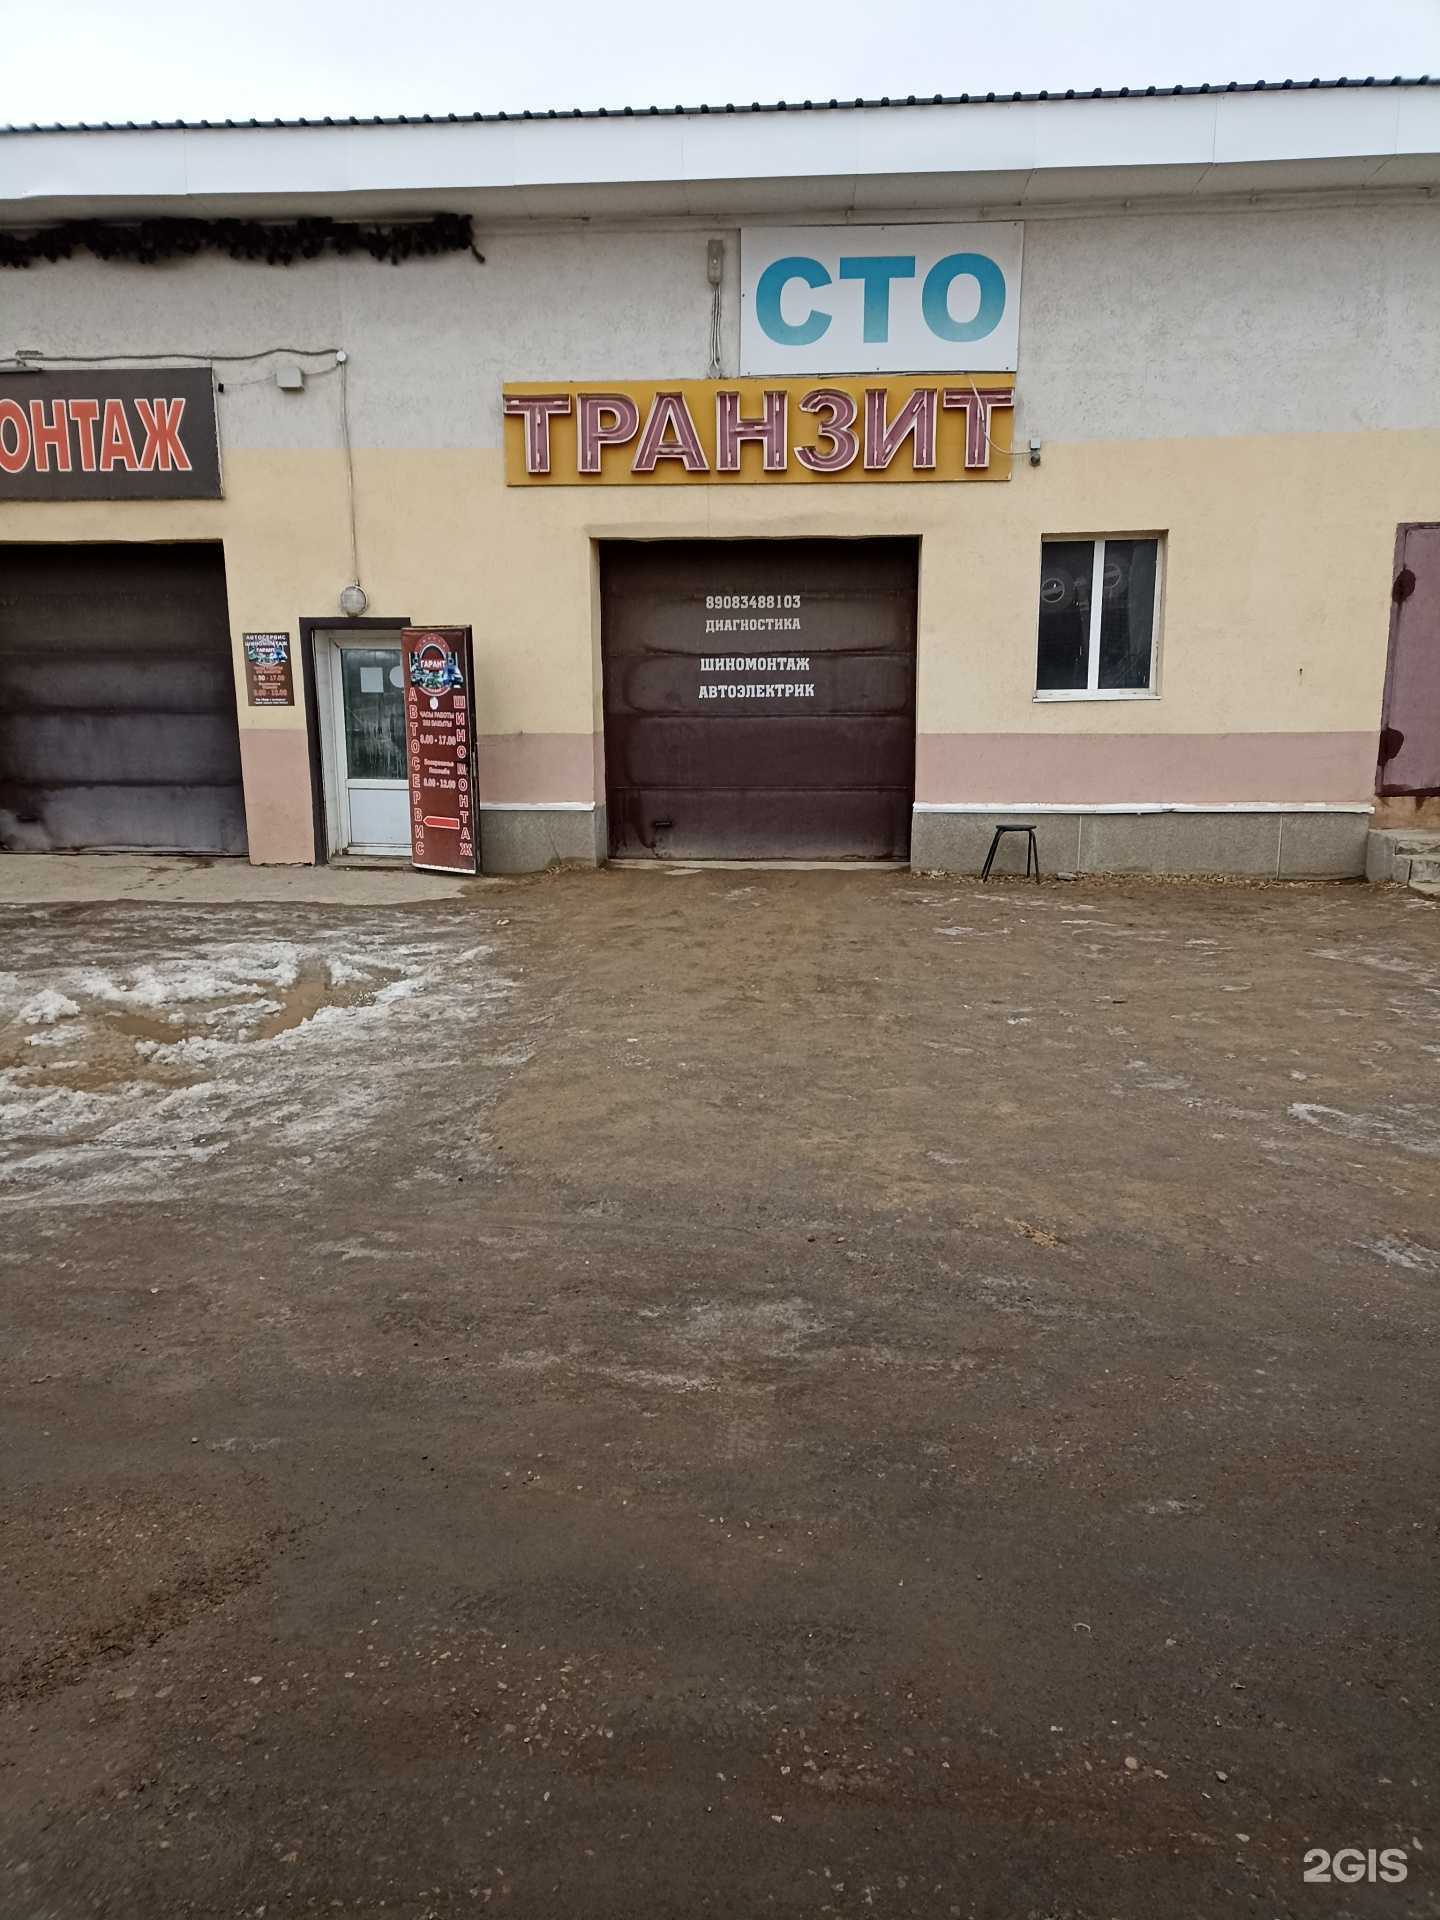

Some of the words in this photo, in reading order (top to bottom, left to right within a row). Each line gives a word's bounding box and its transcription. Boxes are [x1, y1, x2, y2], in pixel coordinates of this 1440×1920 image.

[755, 253, 1007, 346] СТО
[503, 388, 1015, 473] ТРАНЗИТ
[705, 595, 801, 609] 89083488103
[705, 618, 801, 633] ДИАГНОСТИКА
[420, 660, 446, 669] ГАРАНТ
[700, 657, 810, 671] ШИНОМОНТАЖ
[698, 684, 815, 699] АВТОЭЛЕКТРИК
[408, 687, 425, 856] АВТОСЕРВИС
[453, 695, 473, 857] ШИНОМОНТАЖ
